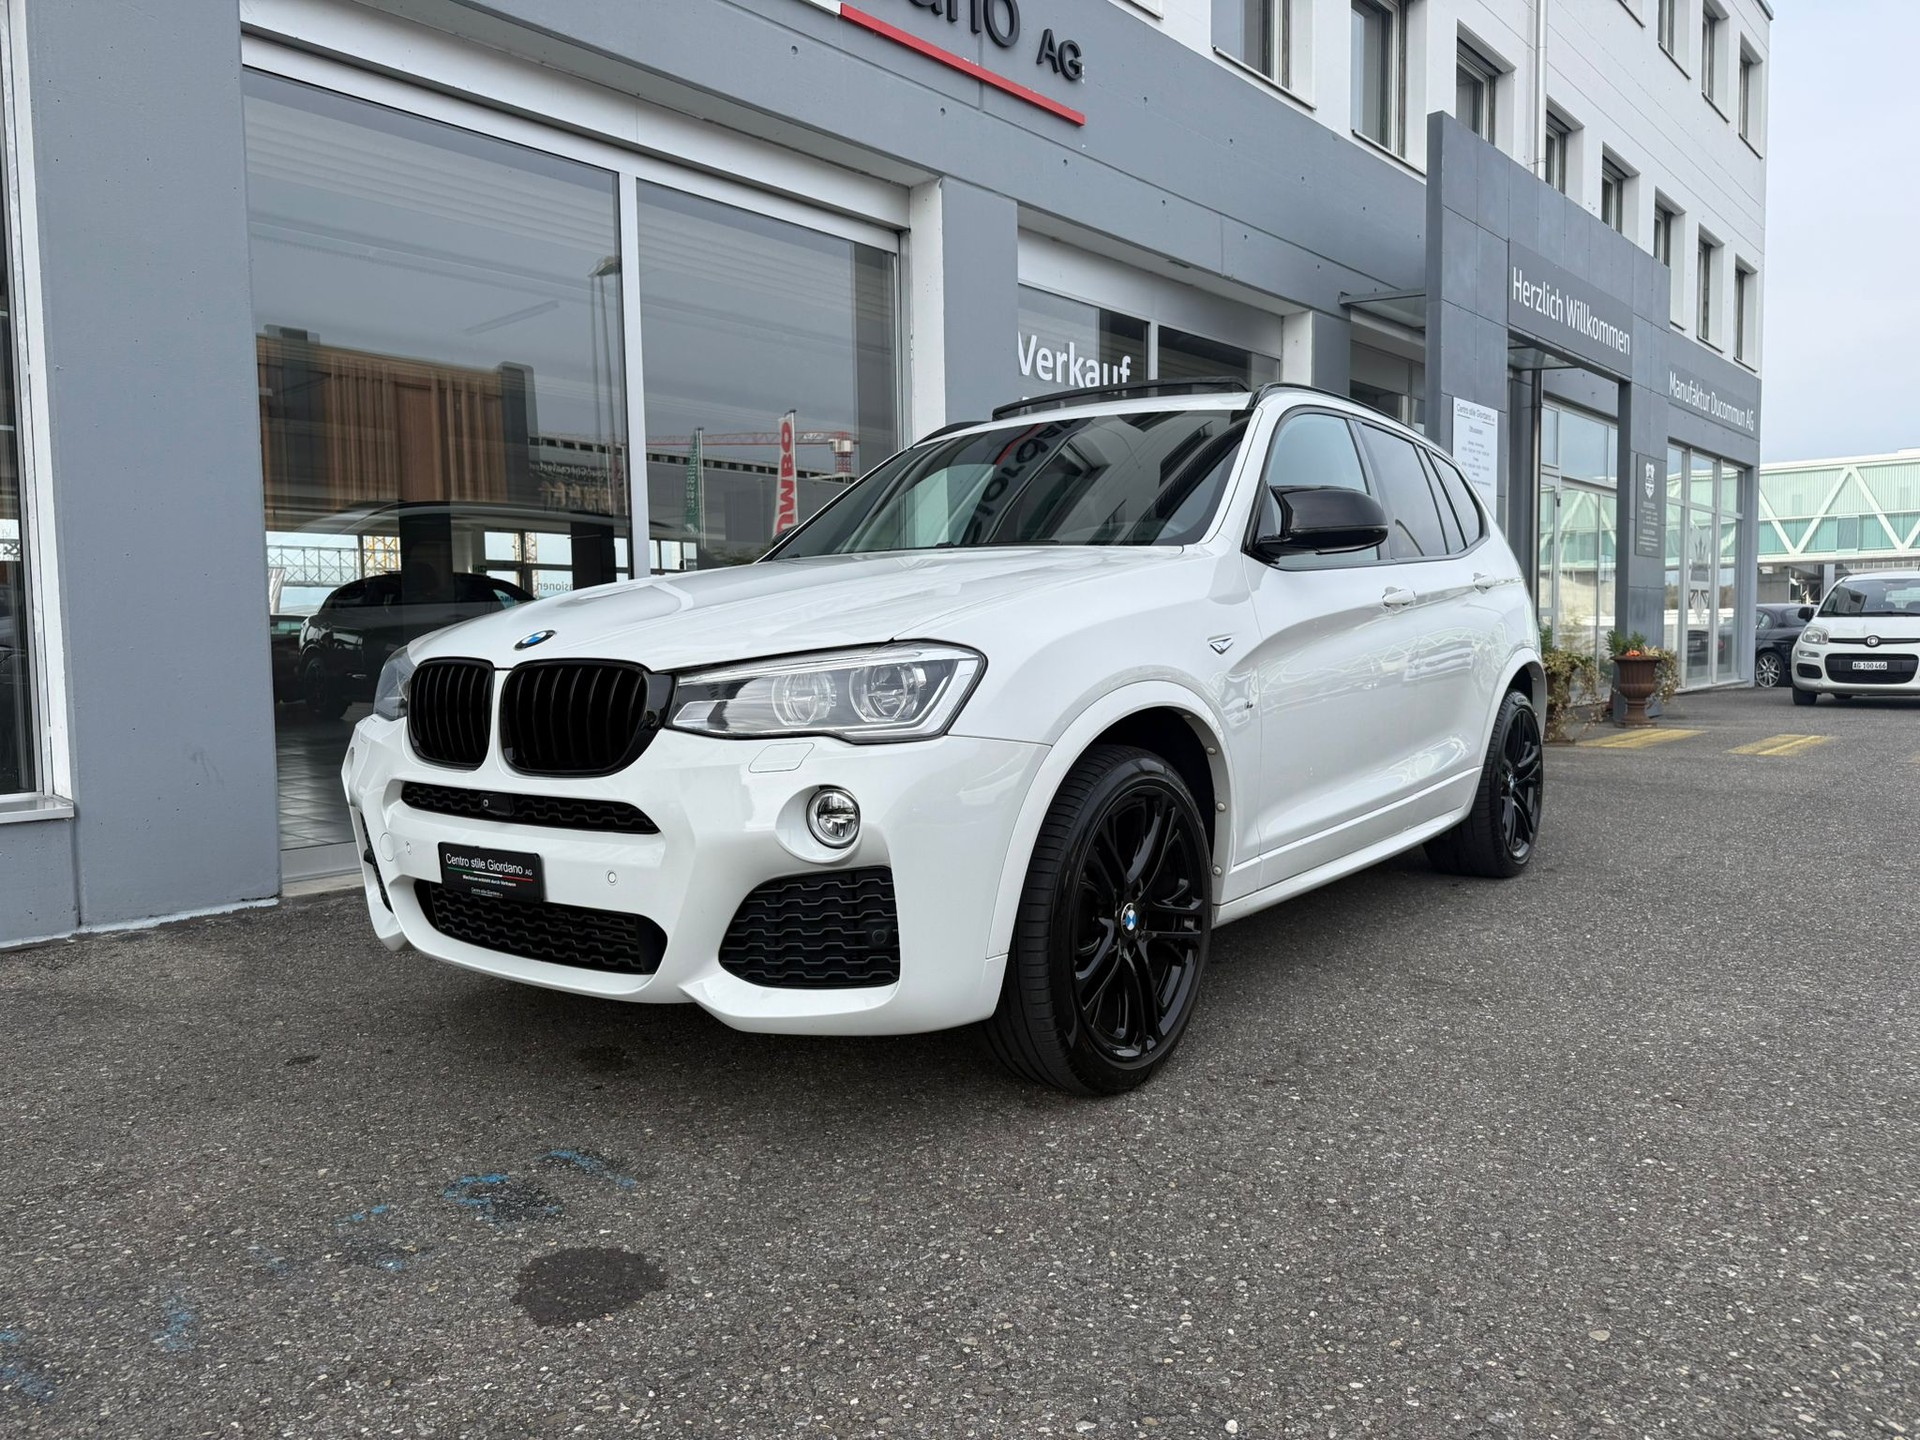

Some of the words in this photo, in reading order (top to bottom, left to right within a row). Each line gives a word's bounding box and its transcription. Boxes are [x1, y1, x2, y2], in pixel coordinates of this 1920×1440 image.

[1036, 28, 1083, 81] AG
[1513, 266, 1563, 323] Herzlich
[1566, 294, 1630, 355] Willkommen
[1018, 331, 1131, 389] Verkauf
[1669, 371, 1710, 412] Manufaktur
[1711, 391, 1746, 428] Ducommun
[1746, 408, 1754, 431] AG
[445, 853, 470, 867] Centro
[470, 857, 486, 870] stile
[487, 859, 523, 875] Giordano
